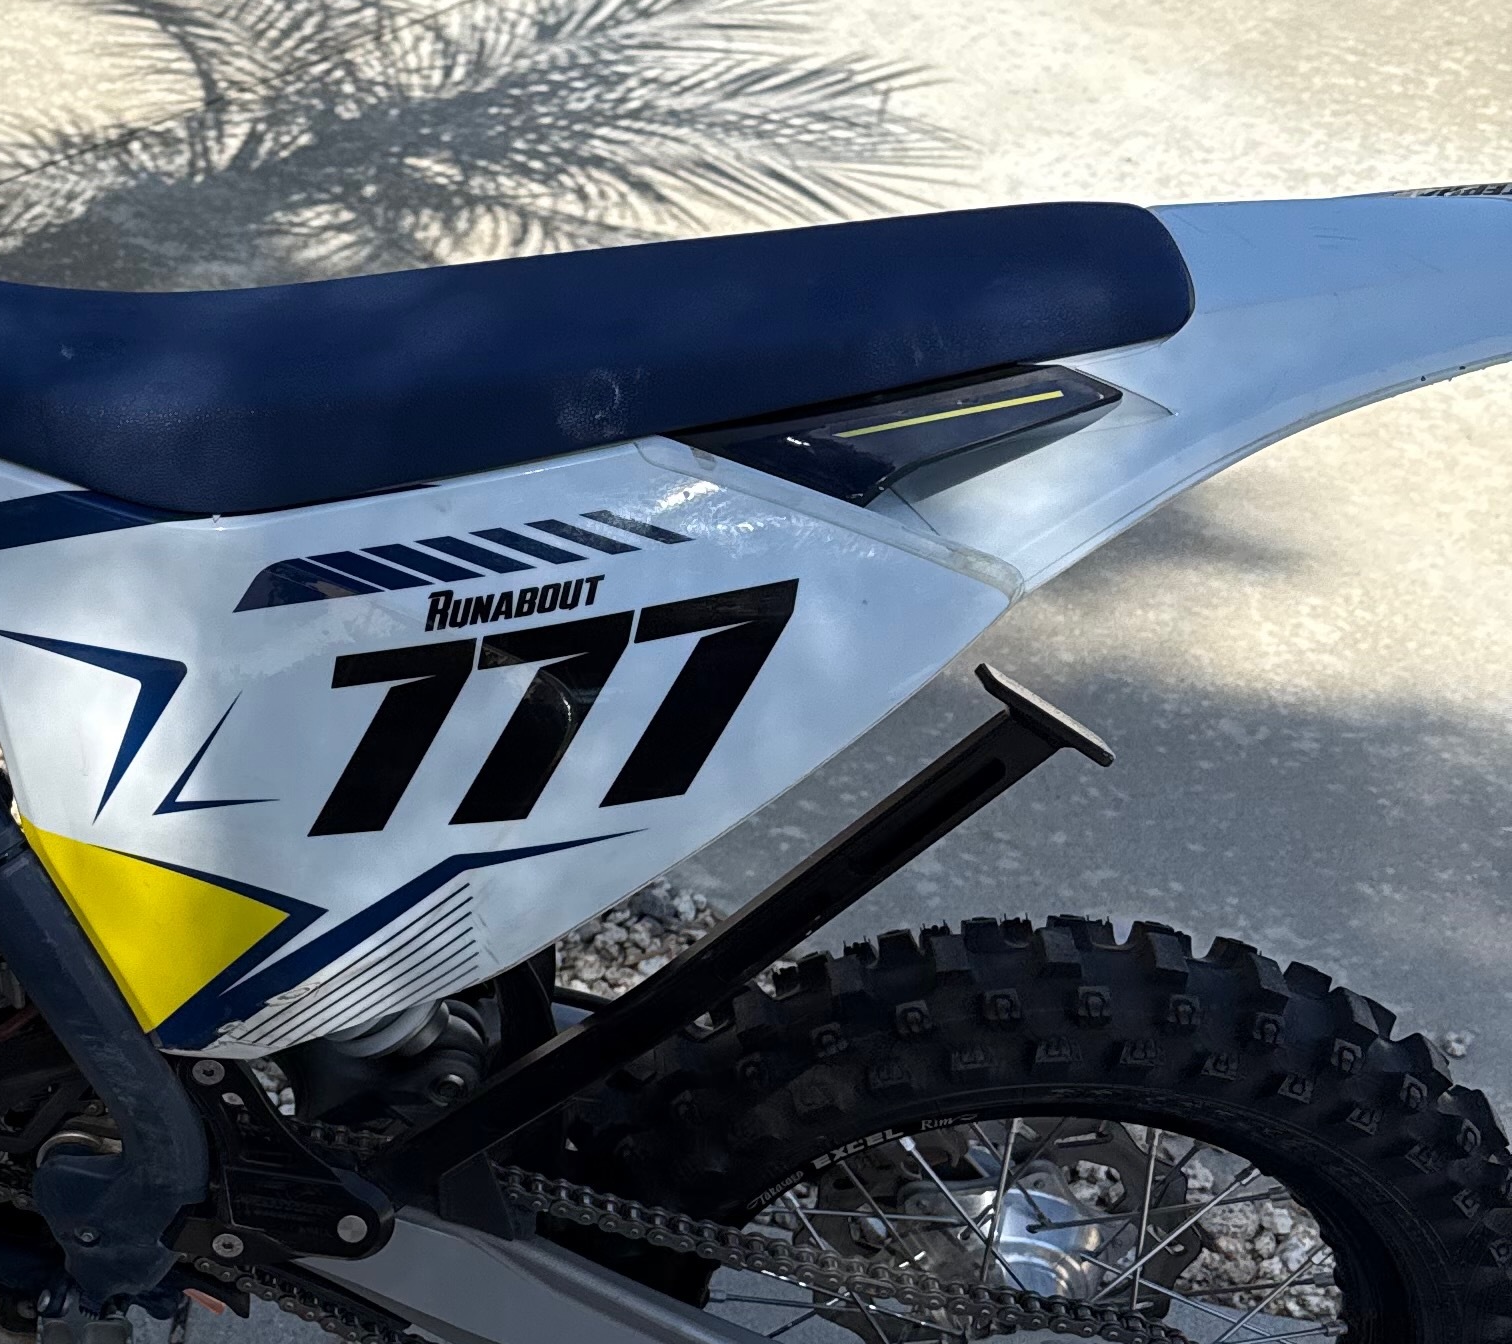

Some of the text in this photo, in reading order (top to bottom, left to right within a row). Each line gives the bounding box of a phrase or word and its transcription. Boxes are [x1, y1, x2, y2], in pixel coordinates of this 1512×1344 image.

[424, 574, 606, 633] RUNABOUT
[307, 577, 800, 838] 777
[810, 1128, 905, 1171] EXCEL
